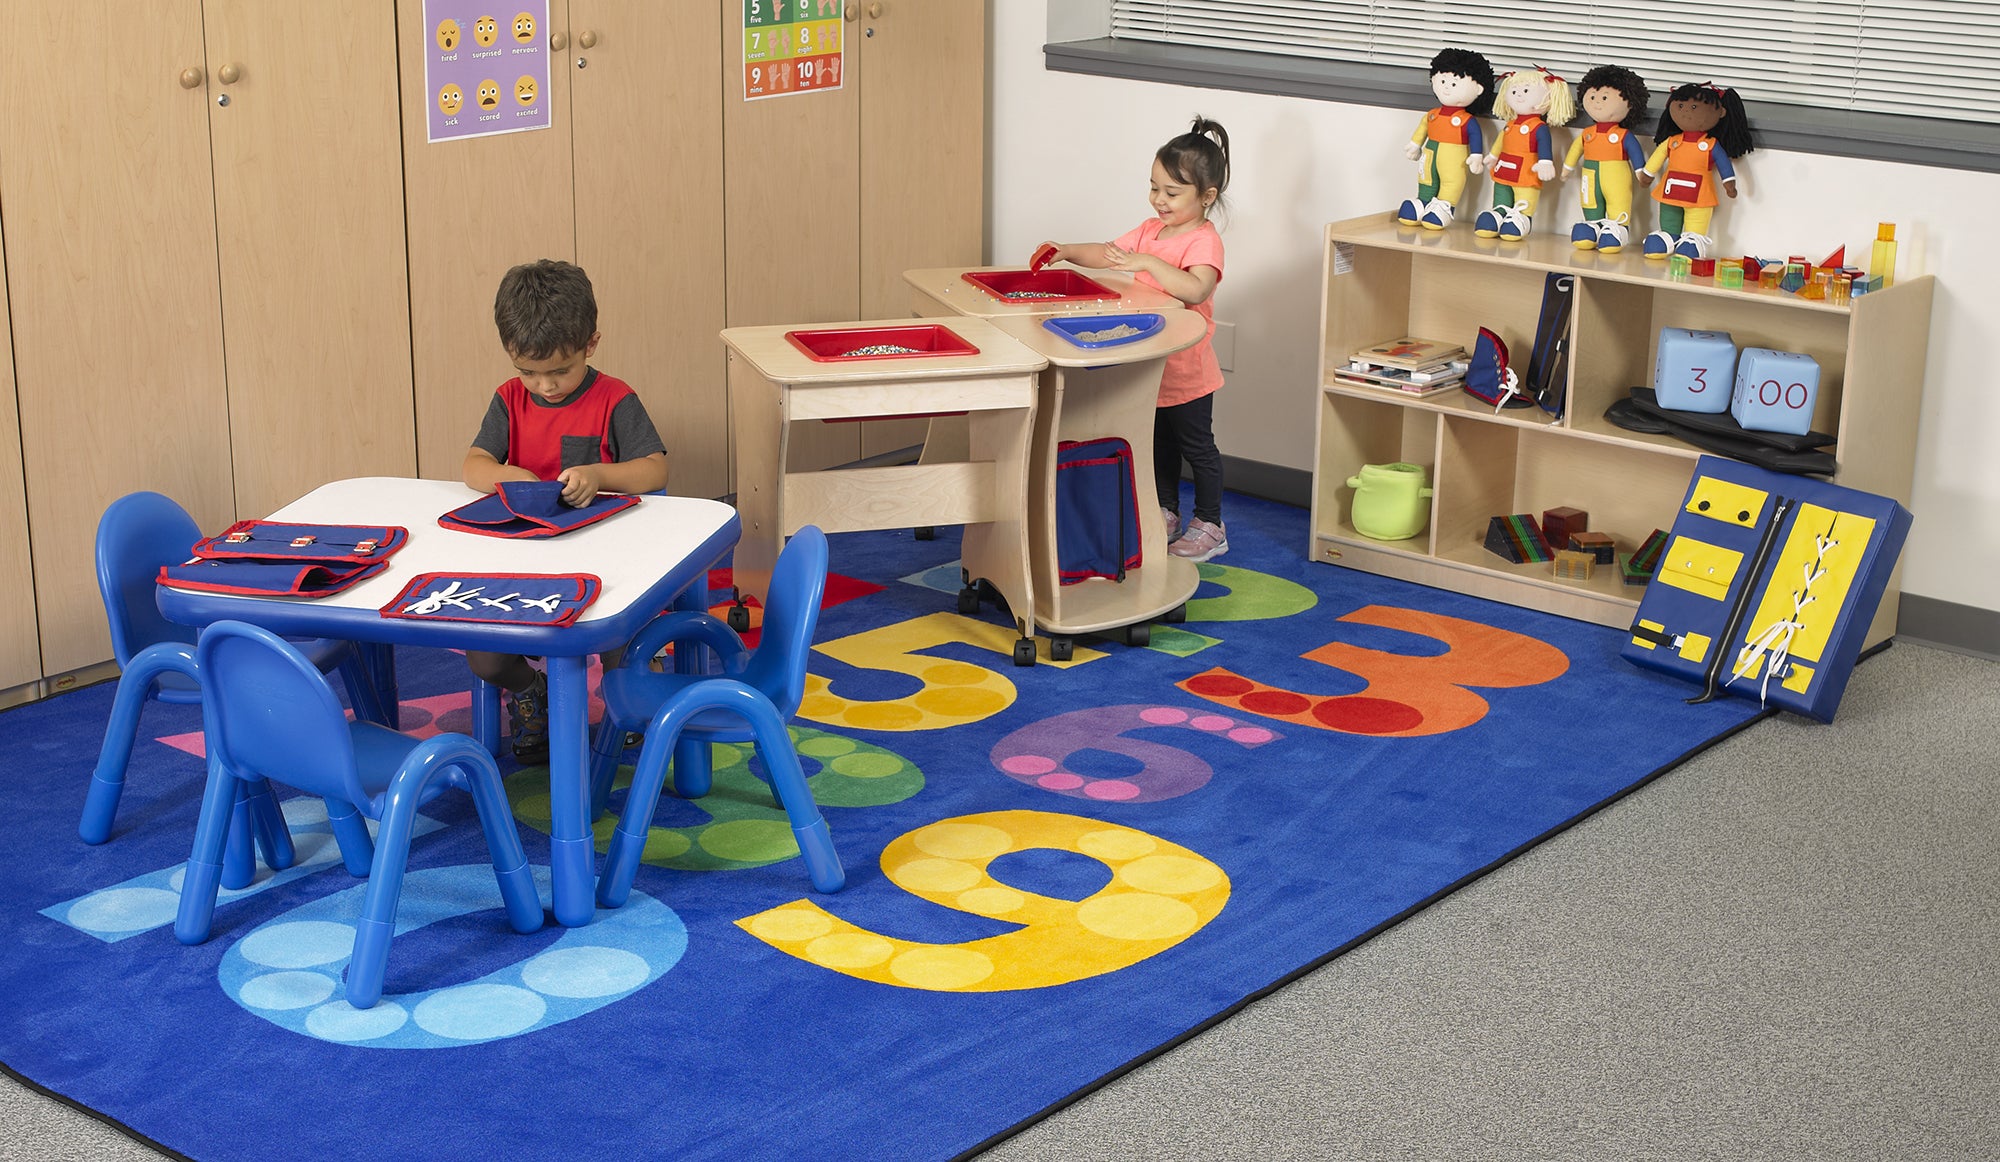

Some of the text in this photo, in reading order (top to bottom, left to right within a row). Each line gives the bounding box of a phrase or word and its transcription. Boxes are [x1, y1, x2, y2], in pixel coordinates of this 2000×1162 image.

[751, 0, 760, 14] 5
[752, 33, 760, 49] 7
[800, 28, 809, 44] 8
[441, 53, 458, 62] tired
[472, 49, 502, 59] surprised
[512, 47, 538, 55] nervous
[797, 46, 813, 54] eight
[751, 67, 761, 84] 9
[797, 61, 813, 78] 10
[516, 108, 538, 117] excited
[445, 117, 459, 127] sick
[1688, 368, 1708, 394] 3
[796, 611, 1111, 731] 5
[1174, 604, 1570, 738] 3
[990, 704, 1285, 803] 6
[733, 810, 1231, 992] 9
